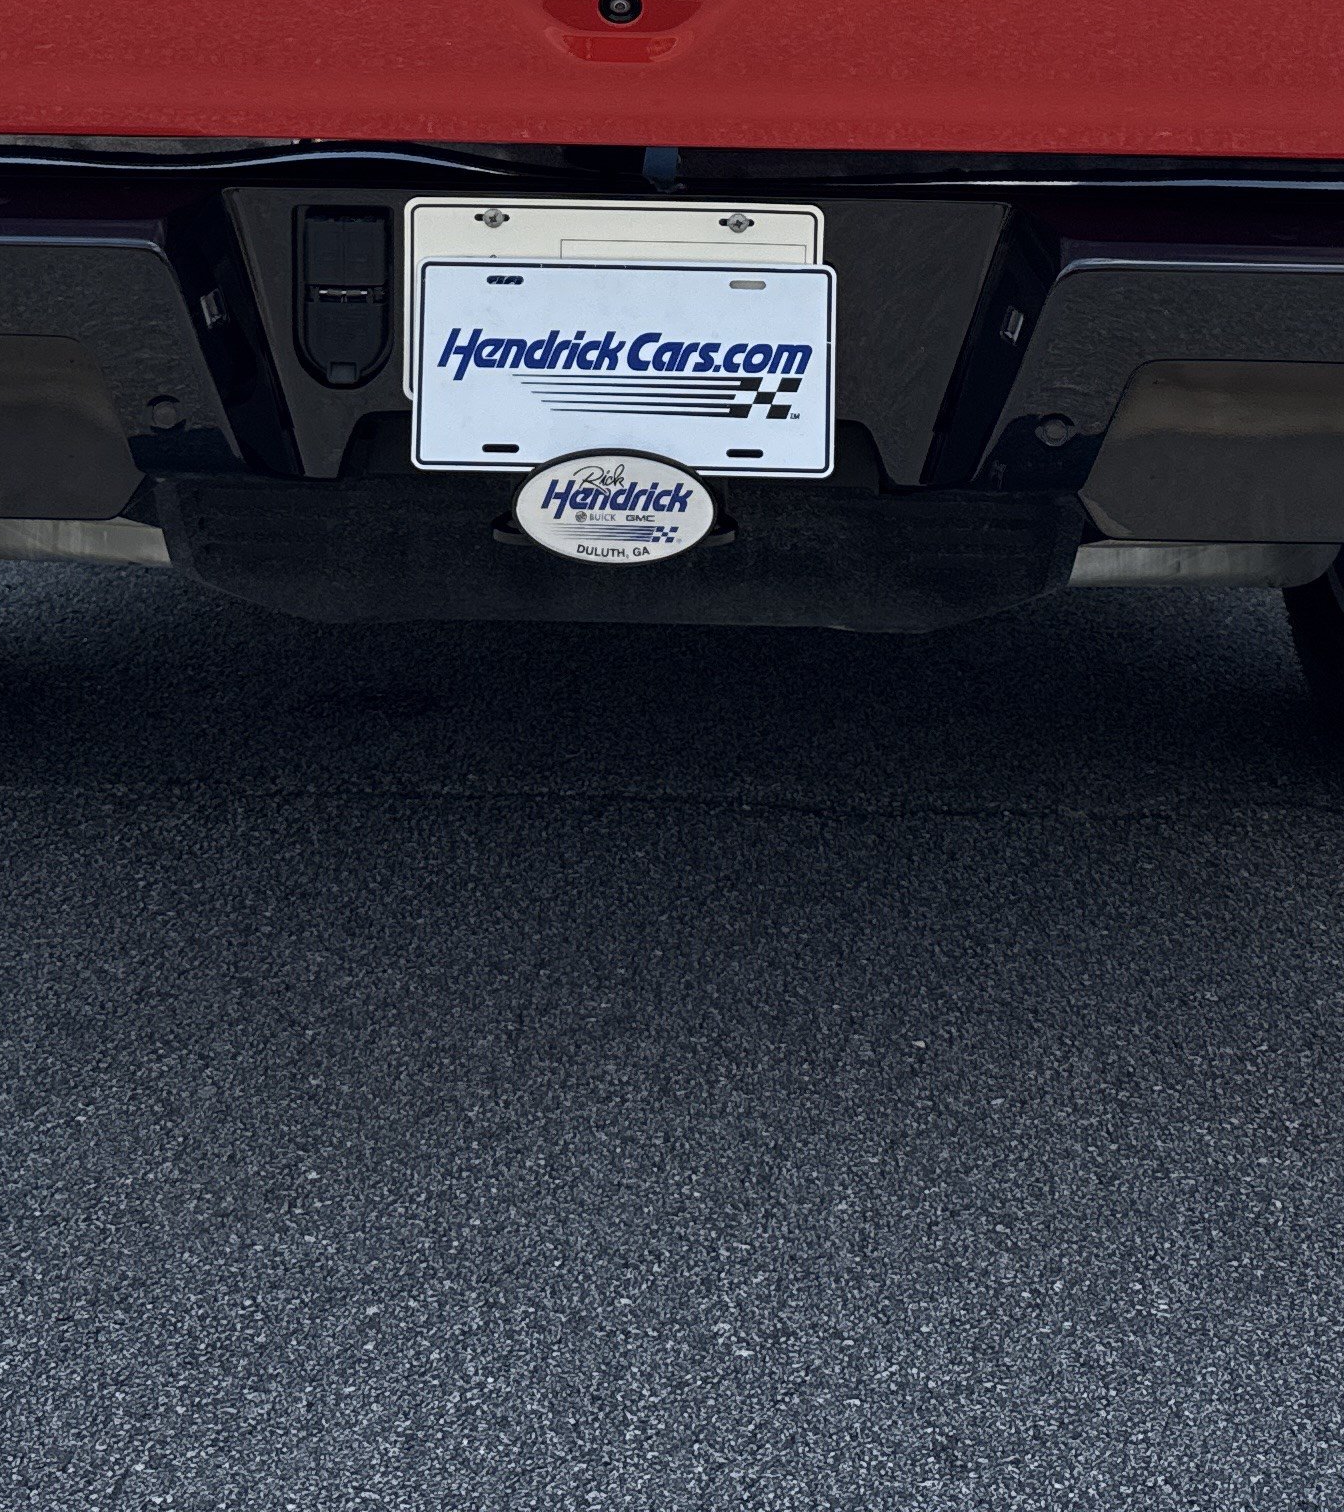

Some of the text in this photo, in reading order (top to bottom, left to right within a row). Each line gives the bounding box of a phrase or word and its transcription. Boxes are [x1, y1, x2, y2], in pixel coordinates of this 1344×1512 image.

[573, 464, 625, 491] Rick
[541, 479, 693, 519] Hendrick
[626, 514, 656, 522] GMC
[577, 544, 650, 559] DULUTH, GA
